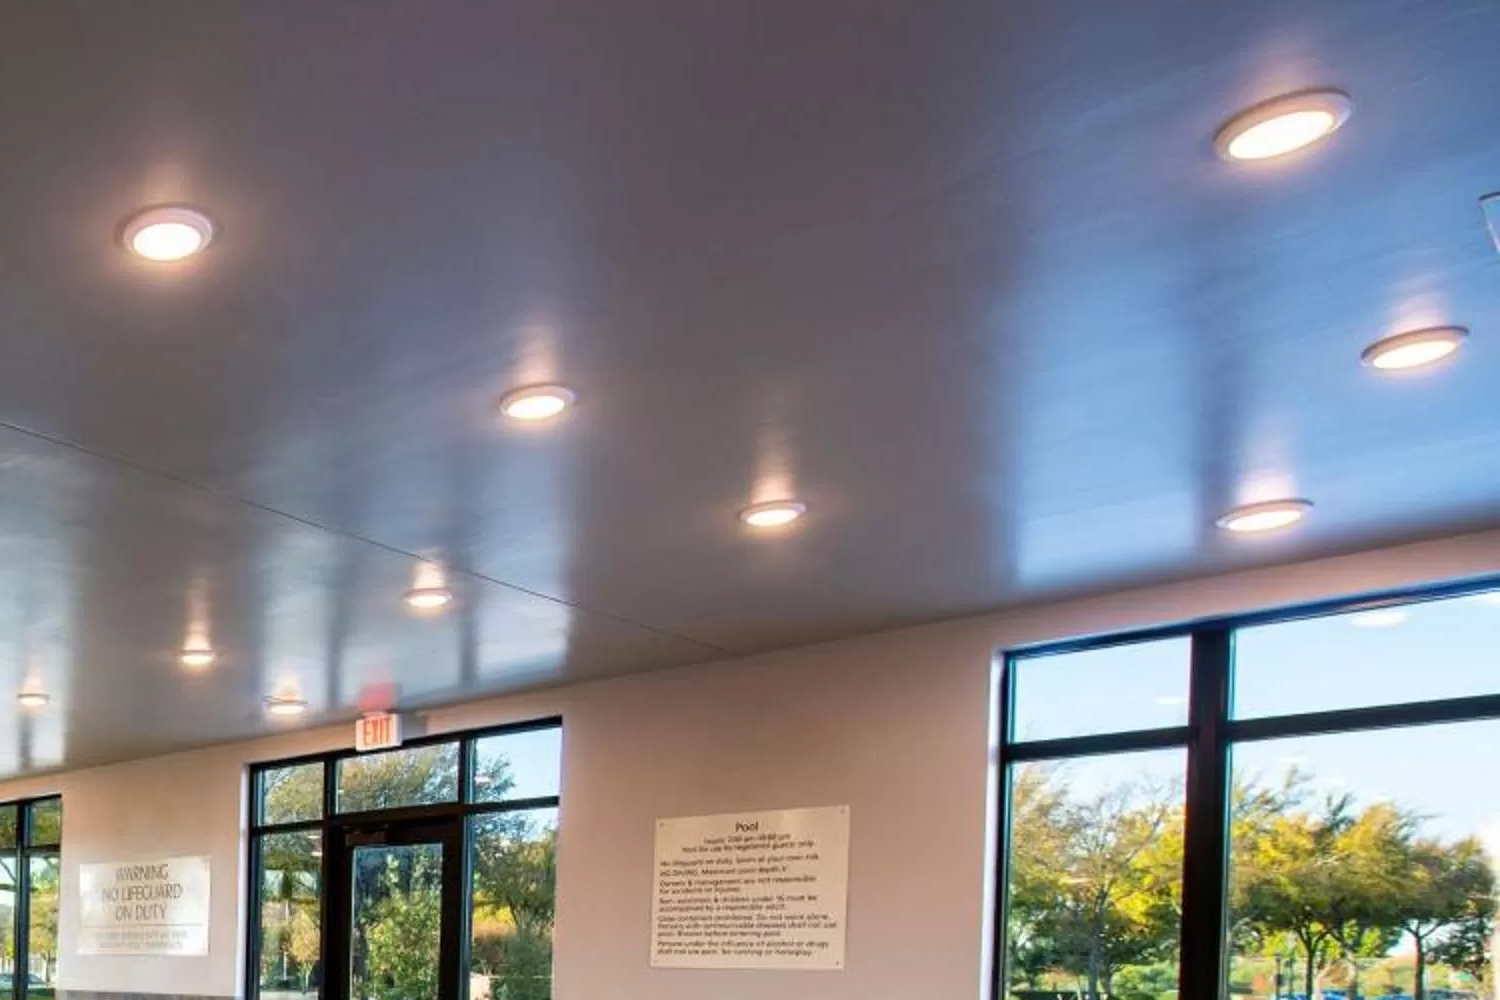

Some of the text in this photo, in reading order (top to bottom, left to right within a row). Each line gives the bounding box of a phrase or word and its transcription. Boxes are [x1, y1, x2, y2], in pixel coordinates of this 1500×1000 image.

[363, 717, 391, 746] EXIT
[736, 820, 758, 833] Pool
[115, 863, 169, 882] WARNING
[102, 883, 183, 901] NO LIFEGUARD
[115, 903, 168, 921] ON DUTY
